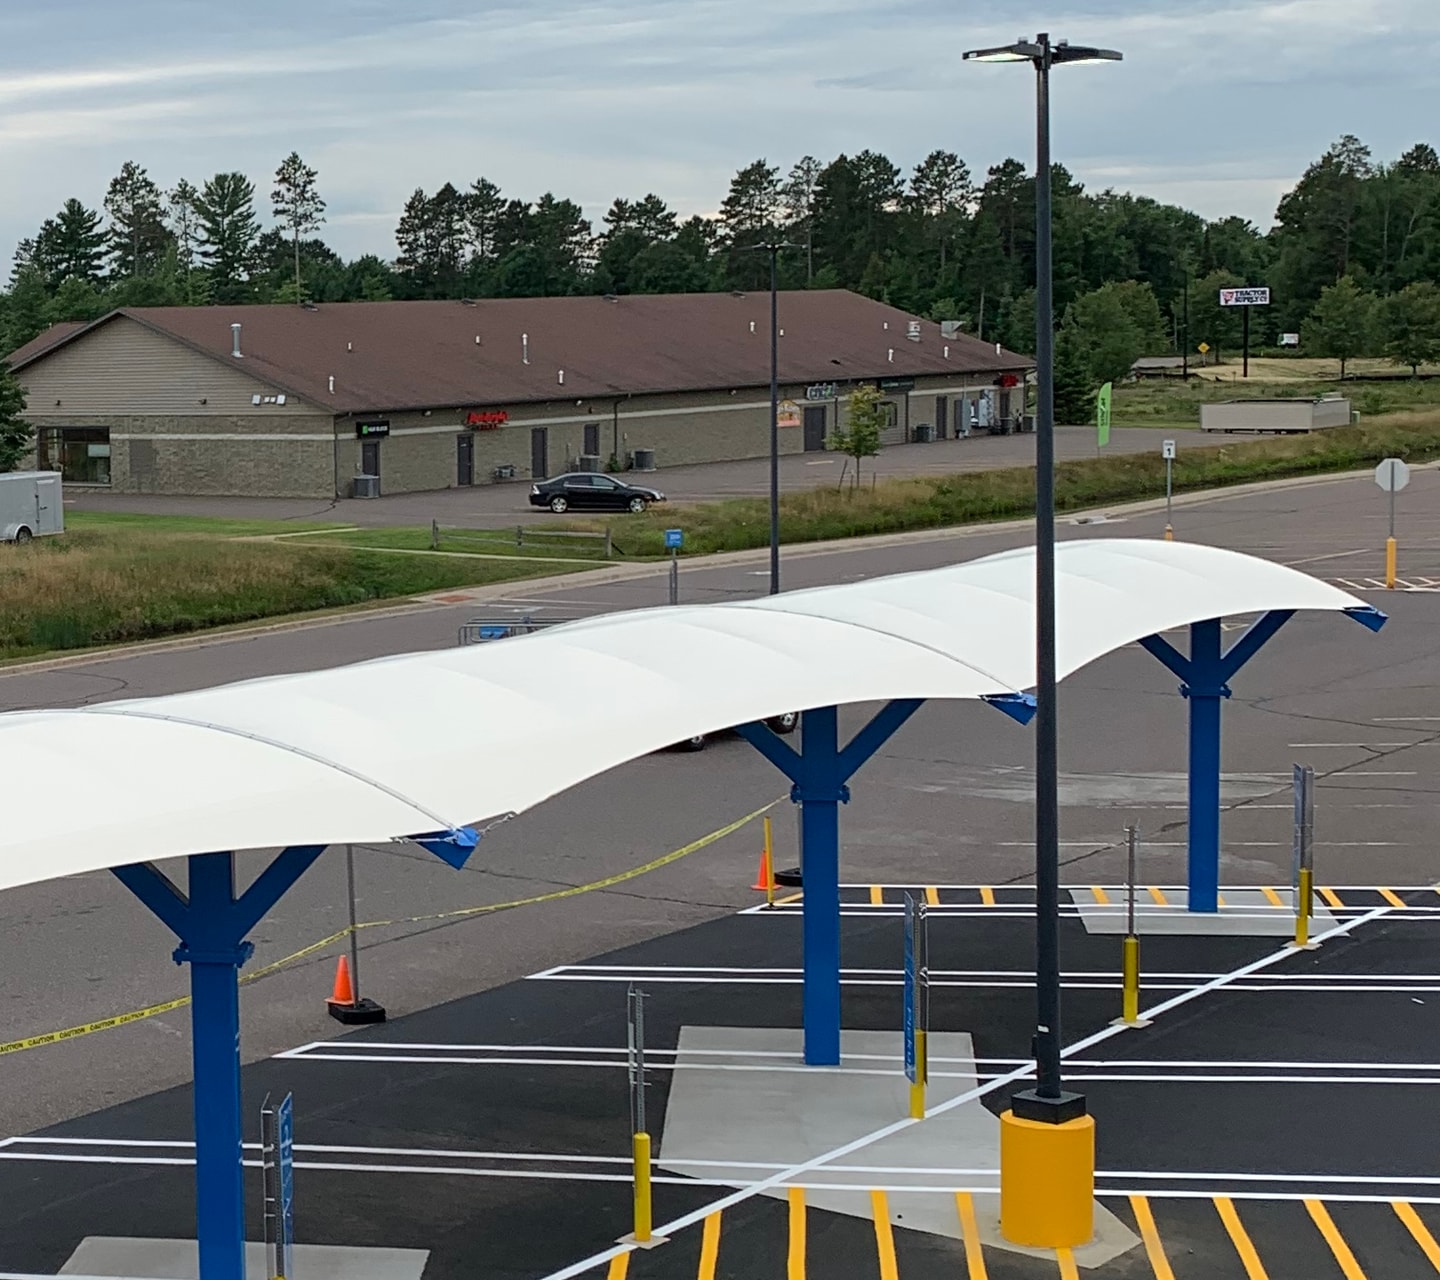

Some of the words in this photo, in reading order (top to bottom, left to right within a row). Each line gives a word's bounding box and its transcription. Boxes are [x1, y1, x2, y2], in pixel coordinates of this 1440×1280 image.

[28, 1035, 55, 1046] CAUTION
[59, 1027, 85, 1039] CAUTION
[90, 1019, 115, 1031] CAUTION
[119, 1012, 145, 1023] CAUTION
